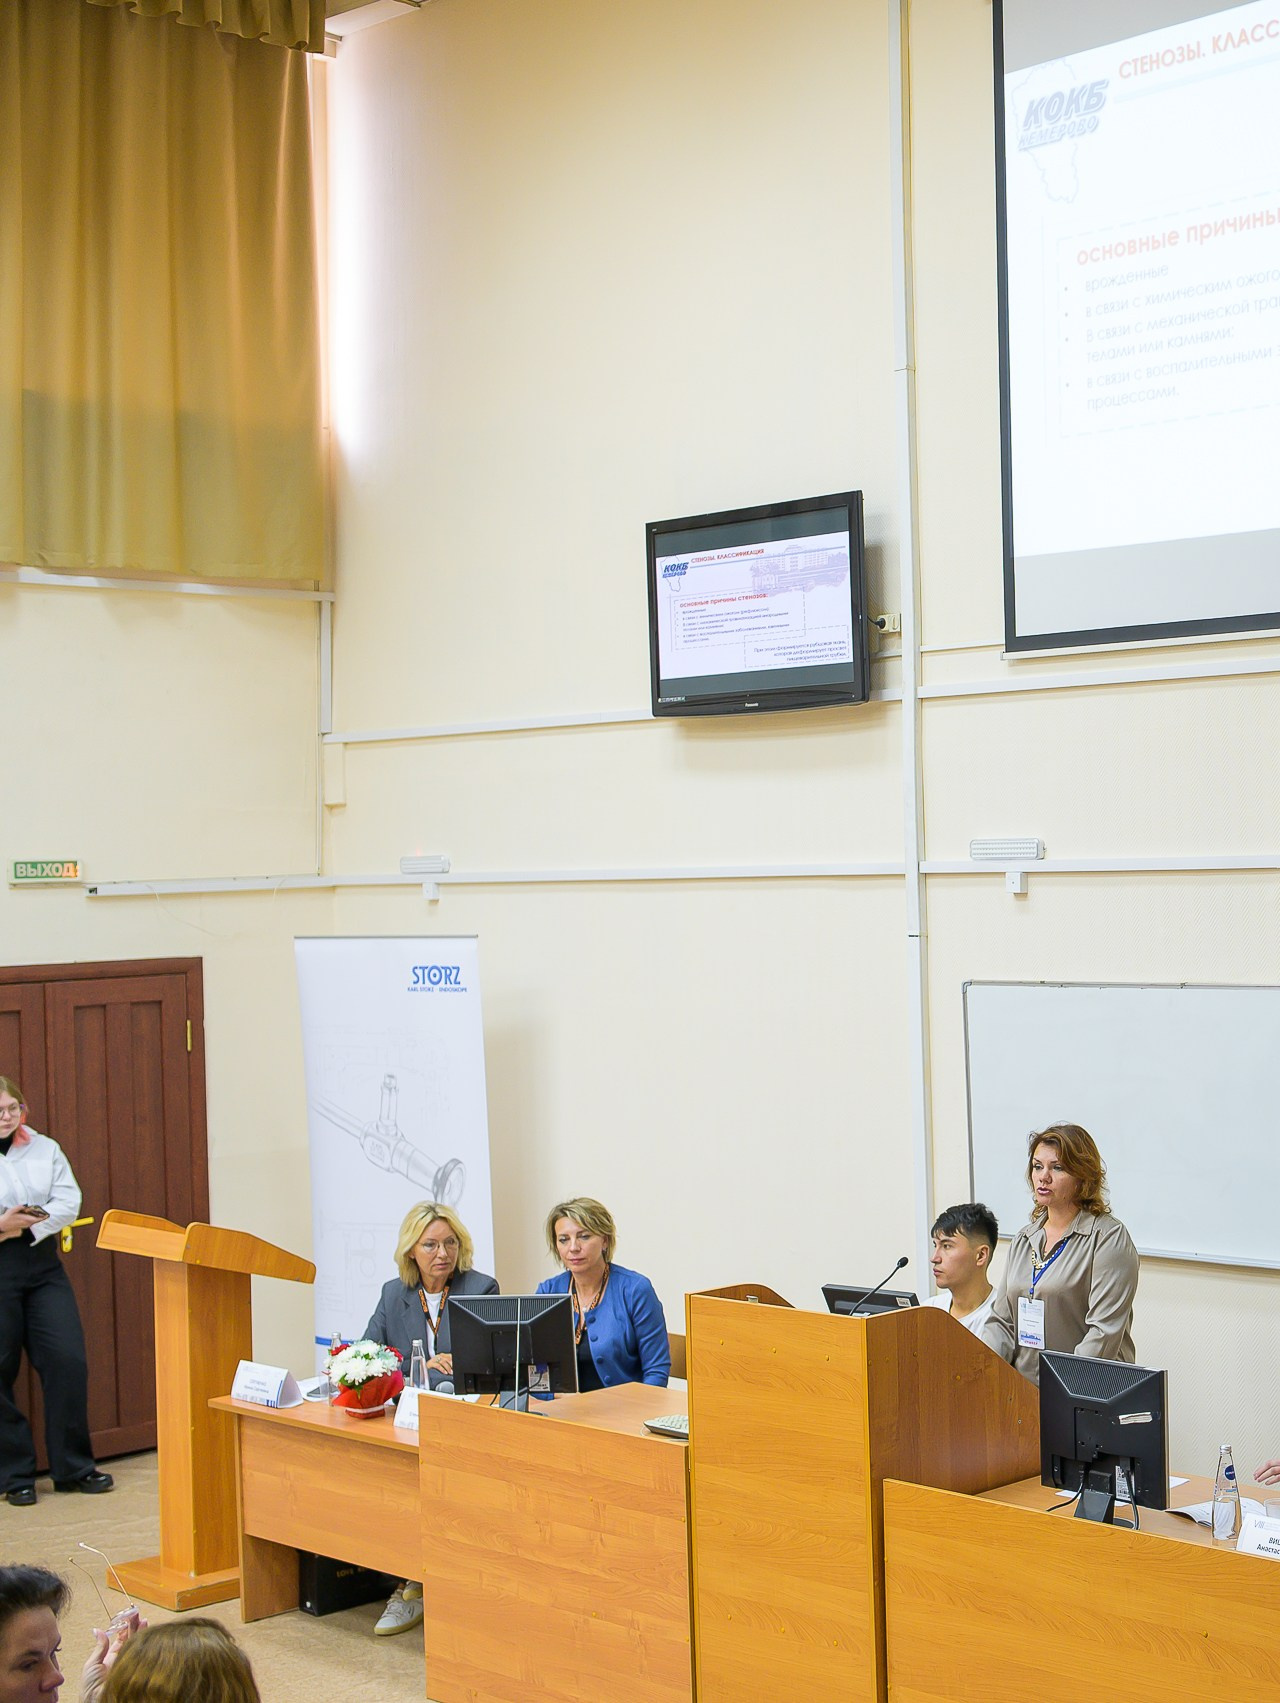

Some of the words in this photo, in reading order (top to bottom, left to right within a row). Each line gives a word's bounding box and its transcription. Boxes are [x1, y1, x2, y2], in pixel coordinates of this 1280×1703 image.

[1118, 41, 1206, 80] СТЕНОЗЫ.
[1022, 78, 1110, 131] КОКБ
[1018, 115, 1100, 149] КЕМЕРОВО
[1076, 230, 1180, 266] основные
[1085, 264, 1169, 294] врожденные
[1085, 306, 1092, 318] в
[1095, 300, 1129, 316] связи
[1132, 296, 1141, 308] с
[1145, 281, 1233, 306] химическим
[1086, 329, 1094, 343] В
[1097, 324, 1131, 341] связи
[1134, 321, 1143, 333] с
[1146, 300, 1250, 331] механической
[1087, 343, 1136, 363] телами
[1139, 339, 1164, 354] или
[1167, 326, 1235, 349] камнями;
[1087, 377, 1093, 389] в
[1096, 371, 1130, 387] связи
[1133, 368, 1142, 380] с
[1146, 346, 1272, 378] воспалительными
[1087, 385, 1180, 411] процессами.
[663, 562, 689, 573] КОКБ
[16, 862, 75, 878] ВЫХОД
[412, 965, 461, 986] STORZ
